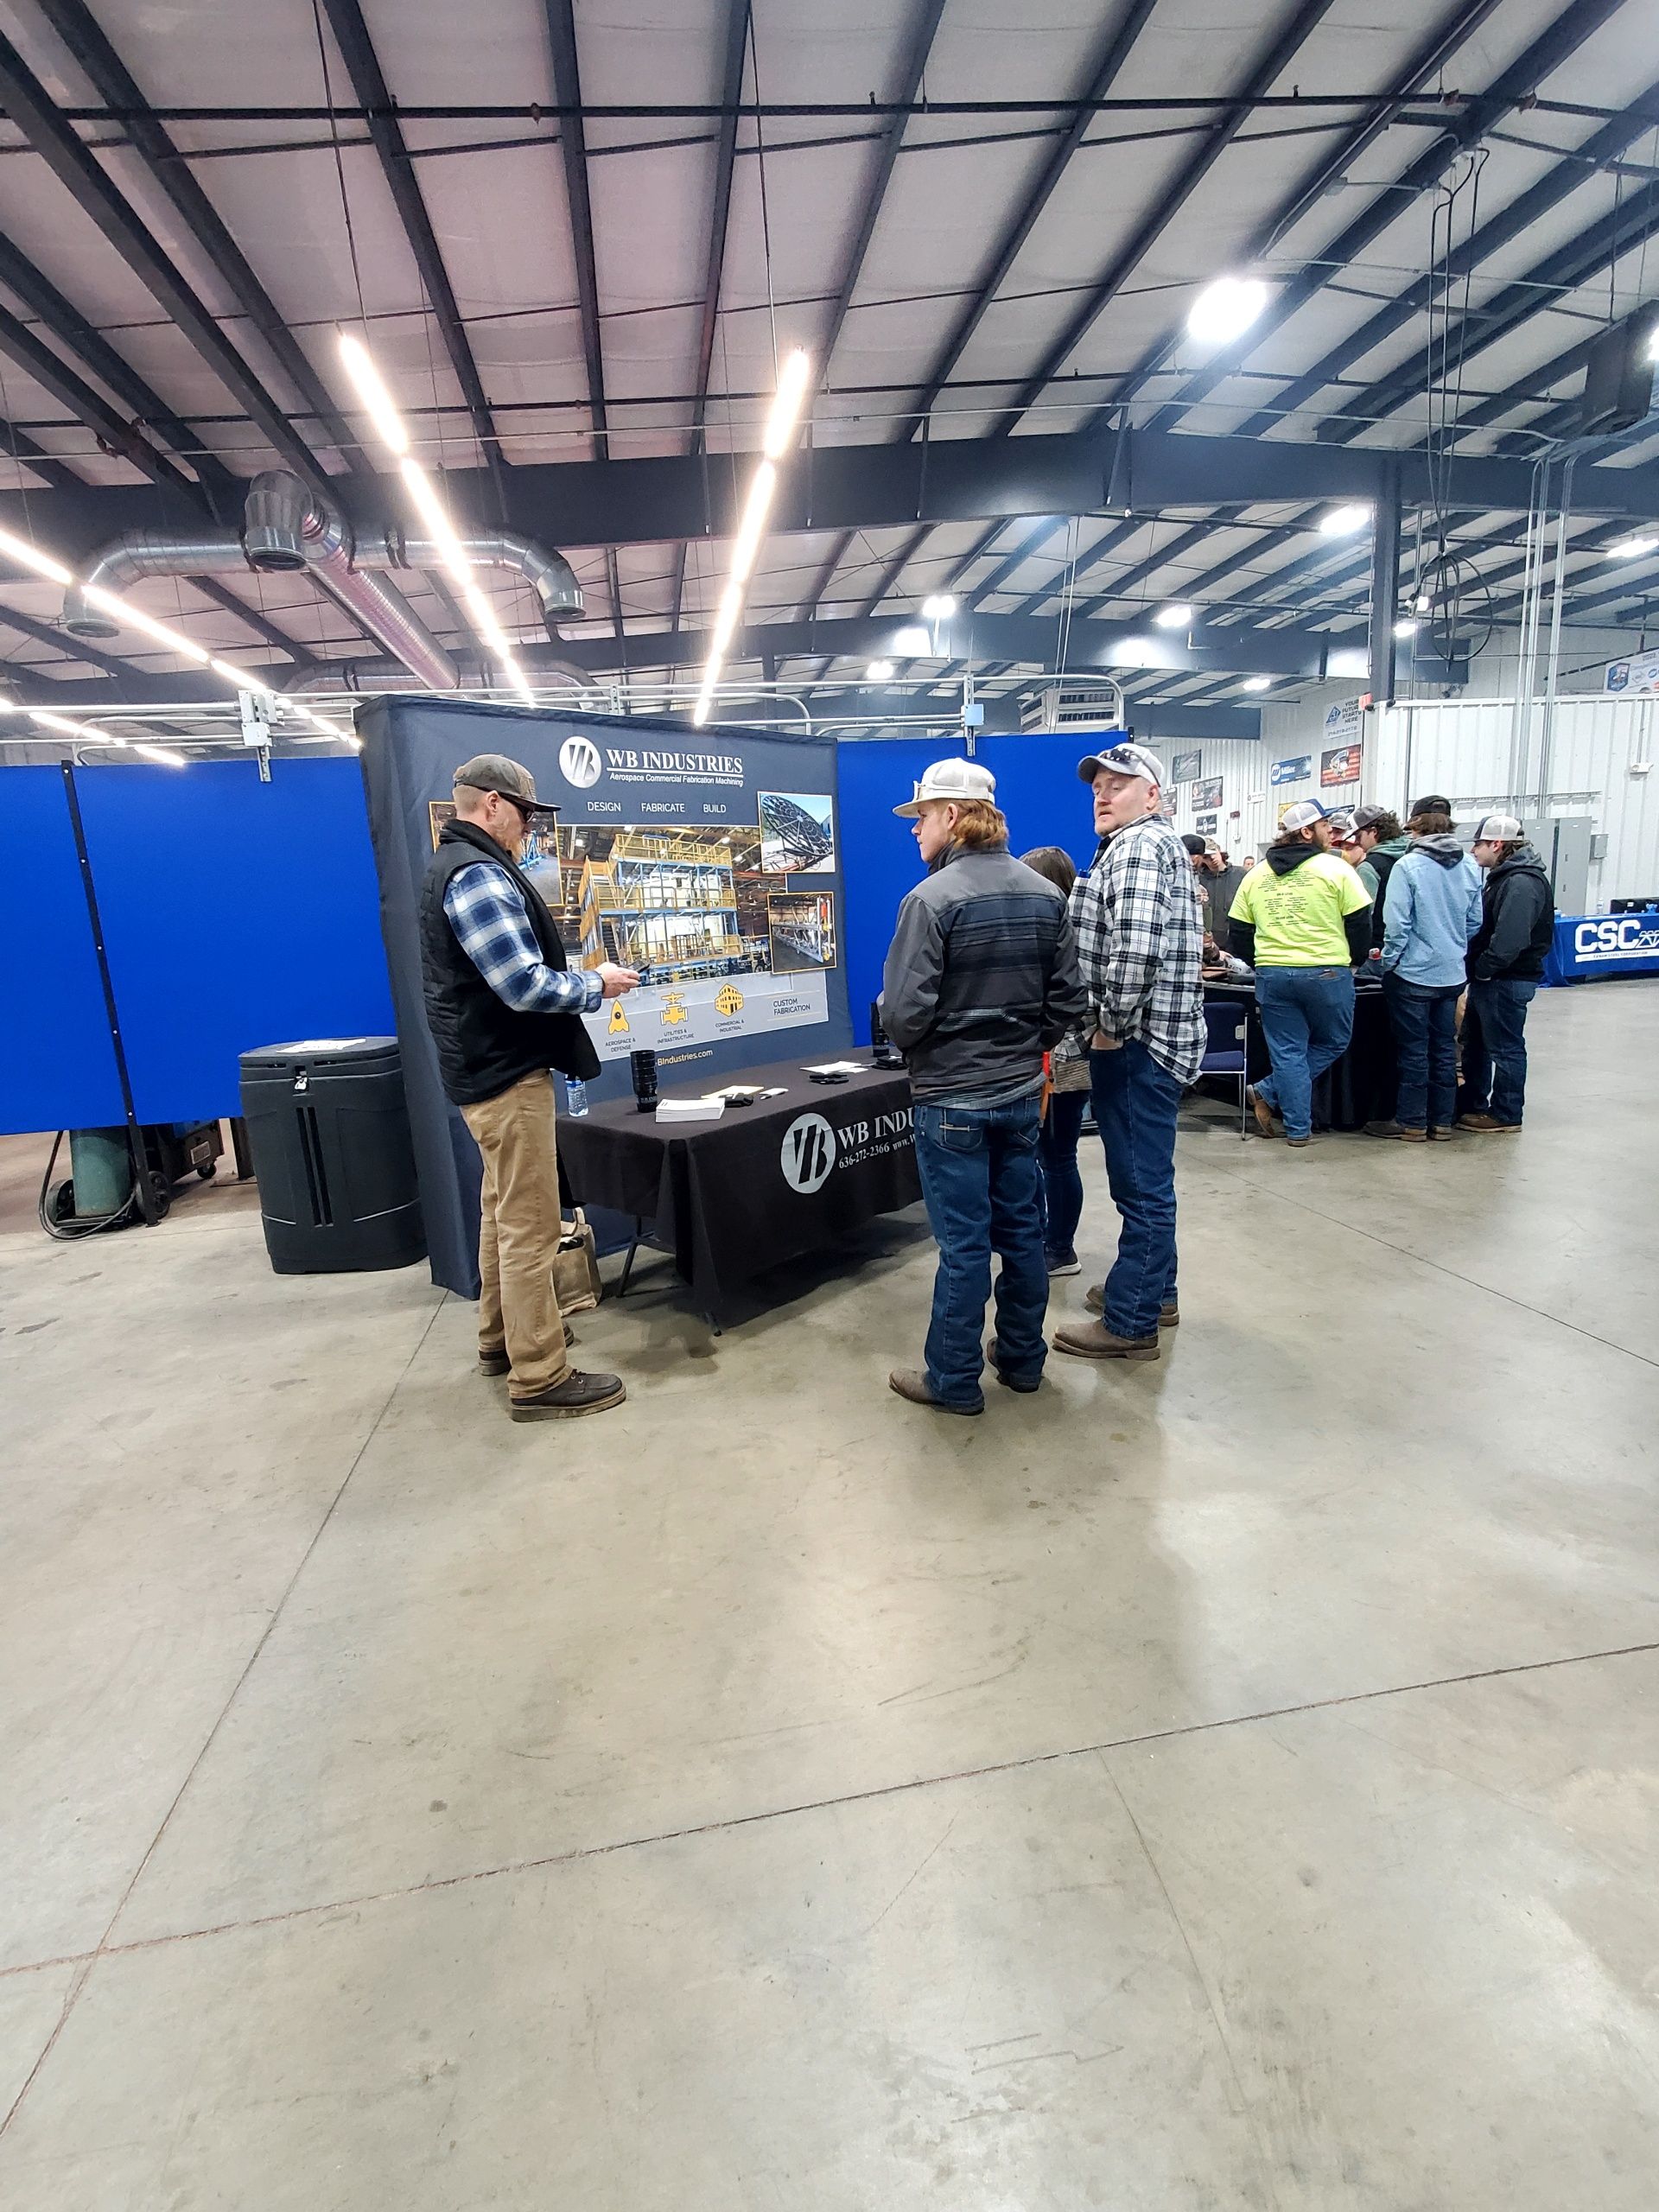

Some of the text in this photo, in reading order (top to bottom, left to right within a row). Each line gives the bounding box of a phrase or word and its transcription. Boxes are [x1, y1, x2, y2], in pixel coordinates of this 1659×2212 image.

[1342, 704, 1359, 713] FUTUR
[606, 748, 743, 774] WB INDUSTRIES
[609, 772, 744, 787] Aerospace Commercial Fabrication Machining
[588, 801, 727, 813] DESIGN FABRICATE BUILD
[1575, 919, 1641, 954] CSC
[772, 998, 798, 1008] CUSTOM
[773, 1003, 810, 1016] FABRICATION
[715, 1020, 740, 1028] COMMERCIAL
[719, 1025, 743, 1033] INDUSTRIAL
[605, 1039, 632, 1047] AEROSPACE
[657, 1033, 695, 1045] INFRASTRUCTURE
[610, 1044, 632, 1052] DEFENSE
[656, 1050, 714, 1066] BIndustries.com
[837, 1121, 869, 1150] WB
[839, 1141, 890, 1169] 636-272-2366
